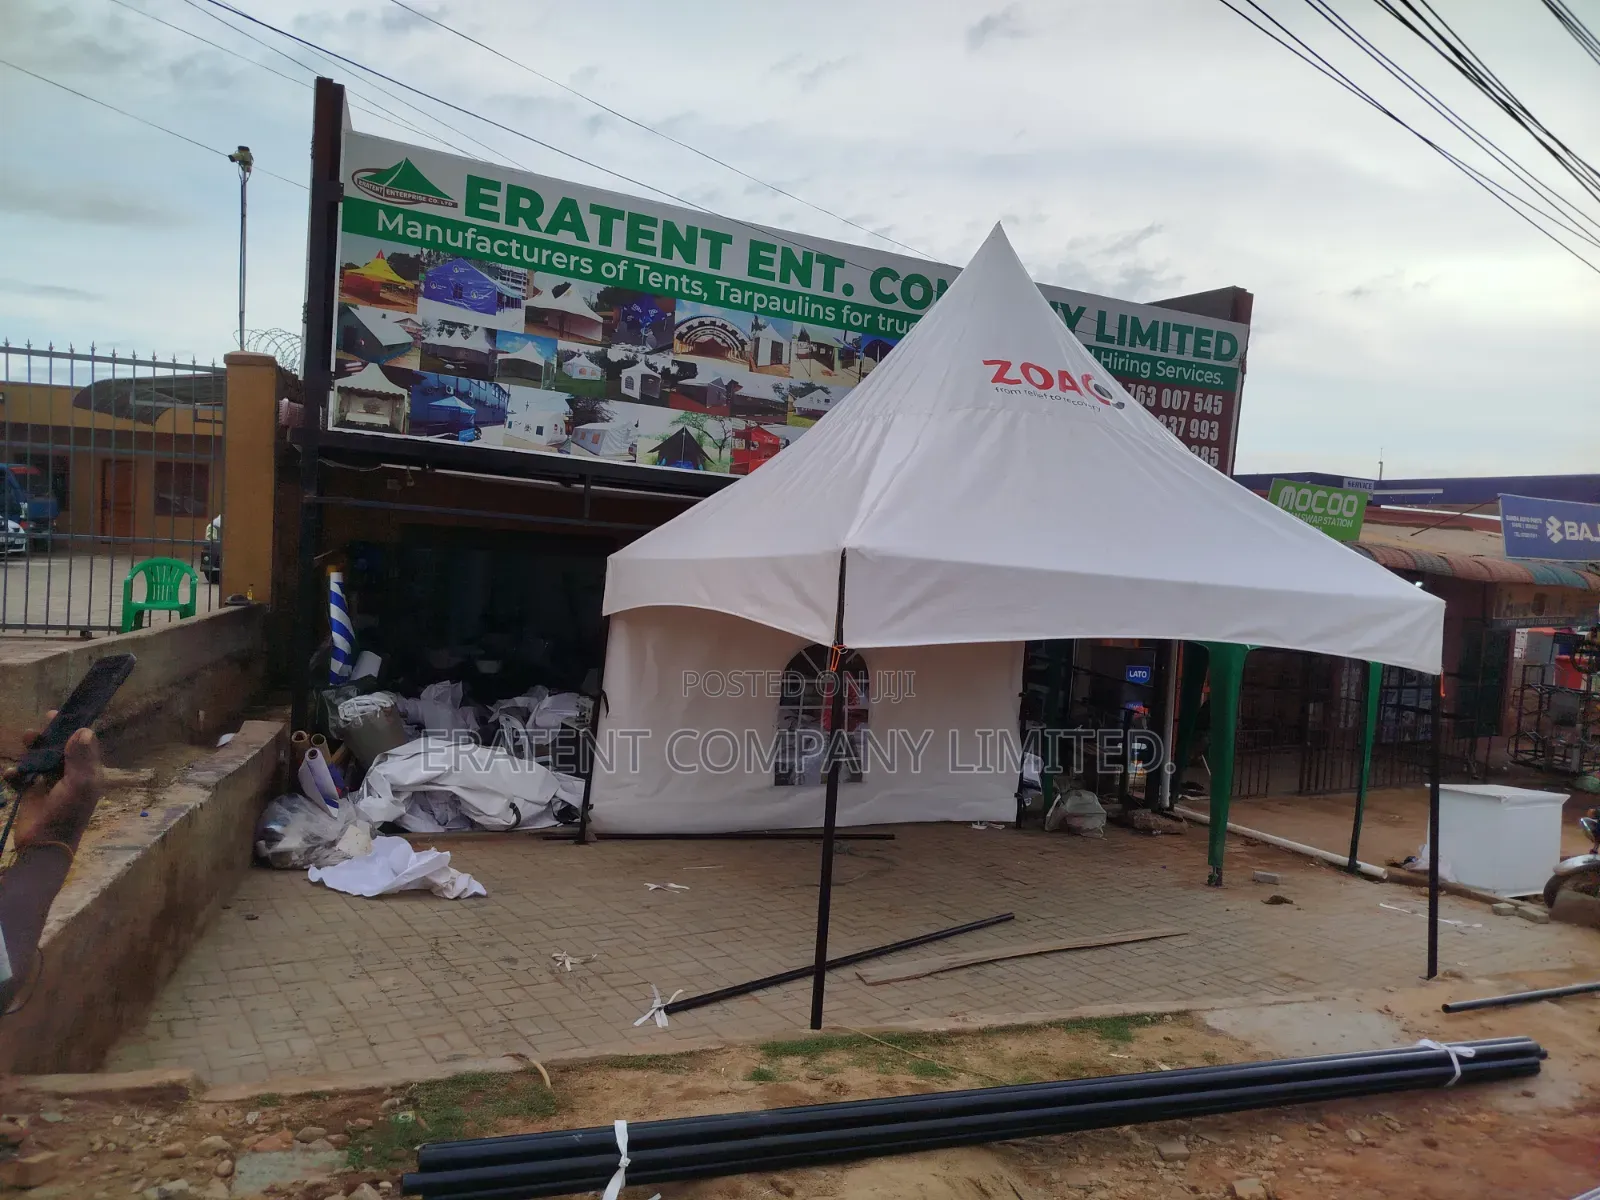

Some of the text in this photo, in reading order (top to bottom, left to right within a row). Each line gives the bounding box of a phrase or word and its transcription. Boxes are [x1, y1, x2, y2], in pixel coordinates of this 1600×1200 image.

[358, 180, 384, 194] ERATENT
[386, 188, 426, 202] ENTERPRISE
[465, 174, 733, 270] ERATENT
[747, 238, 854, 297] ENT.
[1095, 310, 1239, 362] LIMITED
[377, 208, 593, 275] Manufacturers
[601, 260, 628, 281] of
[634, 264, 708, 301] Tents,
[716, 280, 836, 322] Tarpaulins
[842, 305, 872, 328] for
[1100, 351, 1151, 377] Hiring
[1156, 361, 1224, 385] Services.
[995, 387, 1021, 395] from
[1127, 383, 1223, 415] 763 007 545
[1190, 419, 1219, 441] 993
[1347, 480, 1373, 490] SERVICE
[1277, 486, 1359, 517] MOCOO
[1300, 513, 1322, 523] SWAP
[1323, 516, 1354, 528] STATION
[1129, 670, 1148, 678] LATO
